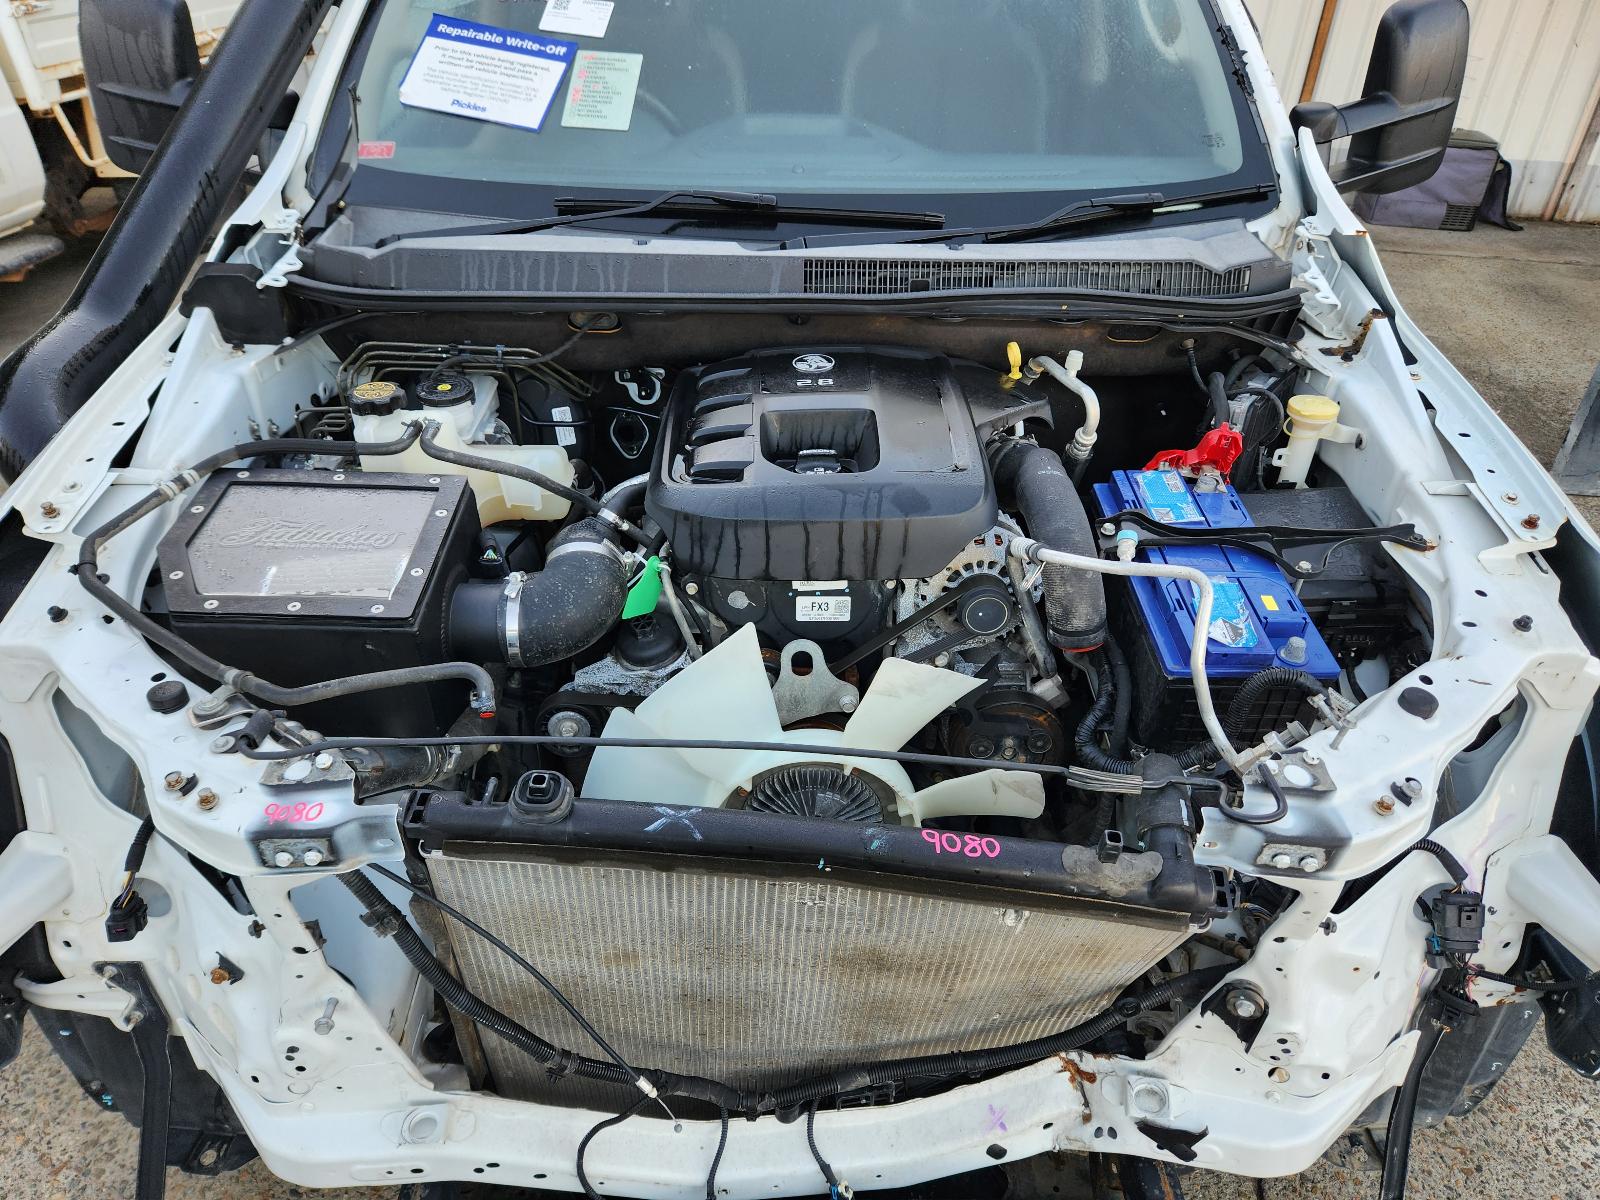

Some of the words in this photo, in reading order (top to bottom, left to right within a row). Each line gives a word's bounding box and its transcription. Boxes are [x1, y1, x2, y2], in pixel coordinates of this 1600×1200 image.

[437, 23, 503, 44] Repairable
[506, 36, 568, 56] Write-Off
[451, 98, 487, 112] Pickles
[796, 378, 834, 386] 2.8
[811, 602, 829, 612] FX3
[264, 801, 325, 825] 9080
[921, 829, 1000, 858] 9080
